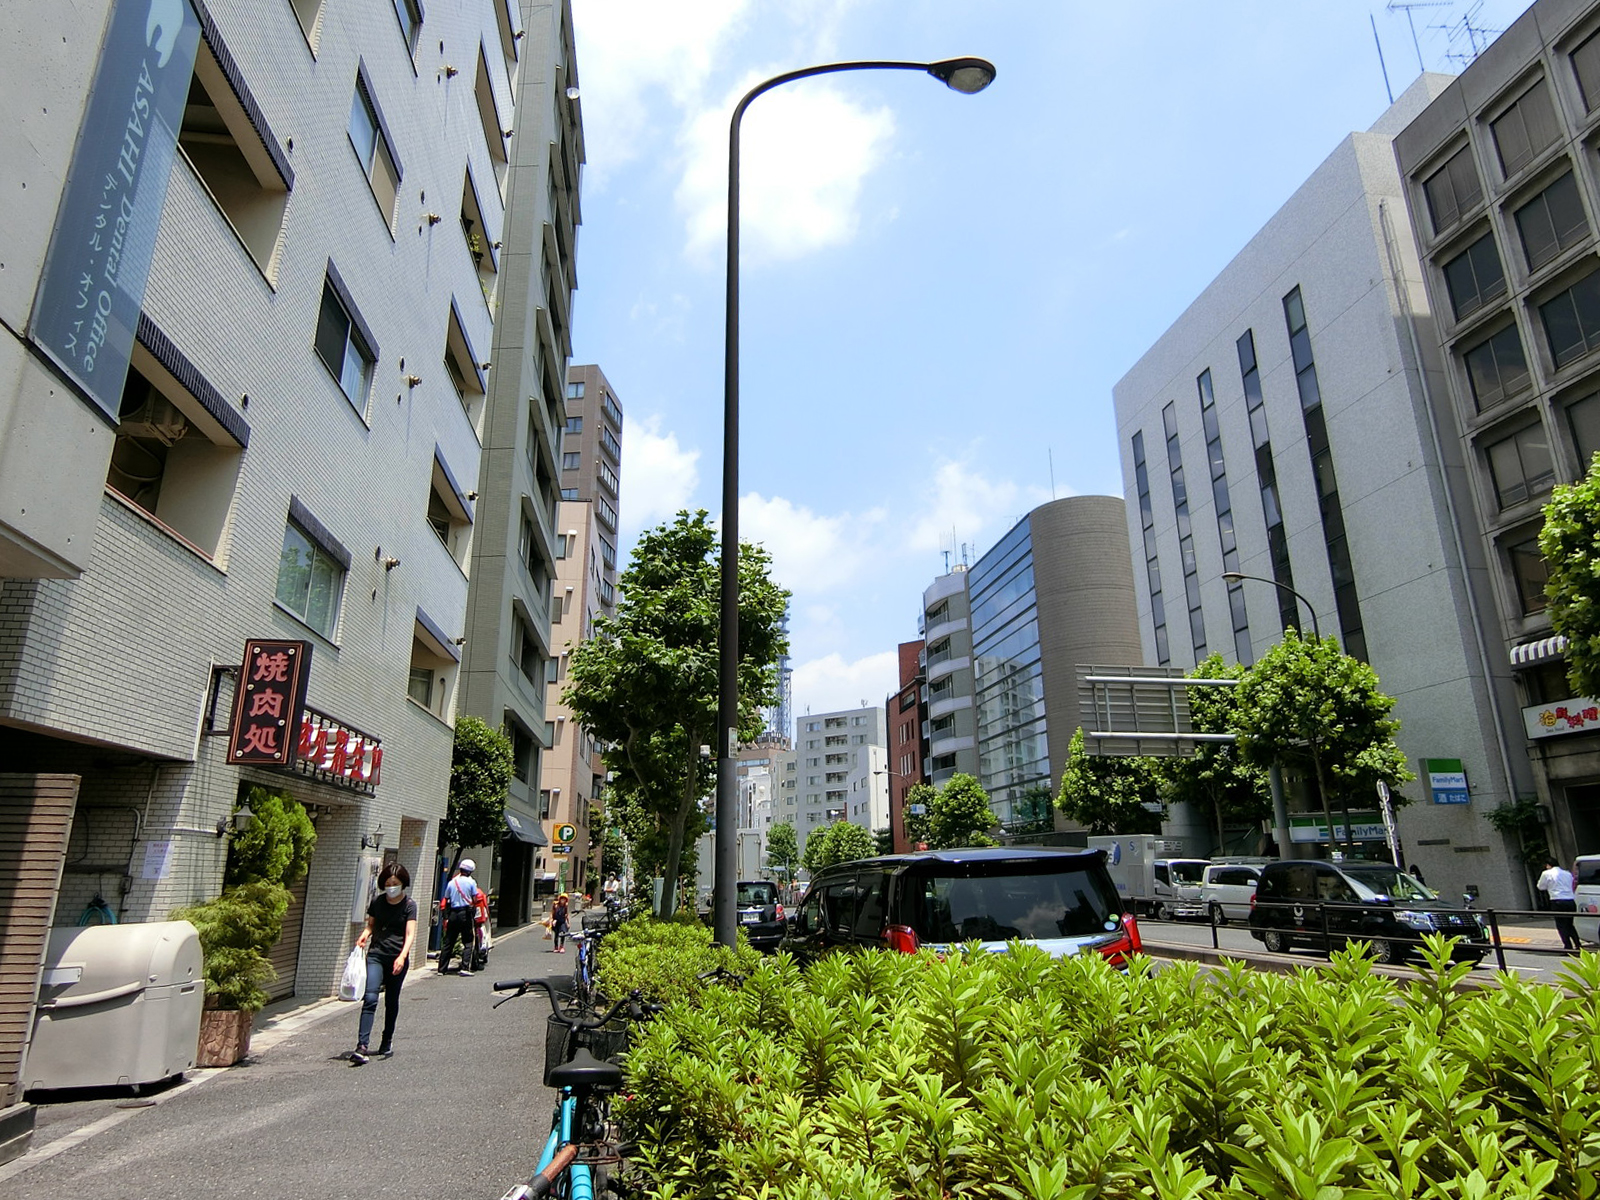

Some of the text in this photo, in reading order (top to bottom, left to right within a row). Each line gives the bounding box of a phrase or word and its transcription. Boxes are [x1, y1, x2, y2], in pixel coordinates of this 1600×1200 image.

[64, 173, 118, 357] デンタル・オフィス
[84, 58, 154, 372] ASAHI Dental Office
[243, 652, 290, 754] 焼肉処
[1432, 776, 1464, 784] FamilyMart
[563, 828, 573, 840] P
